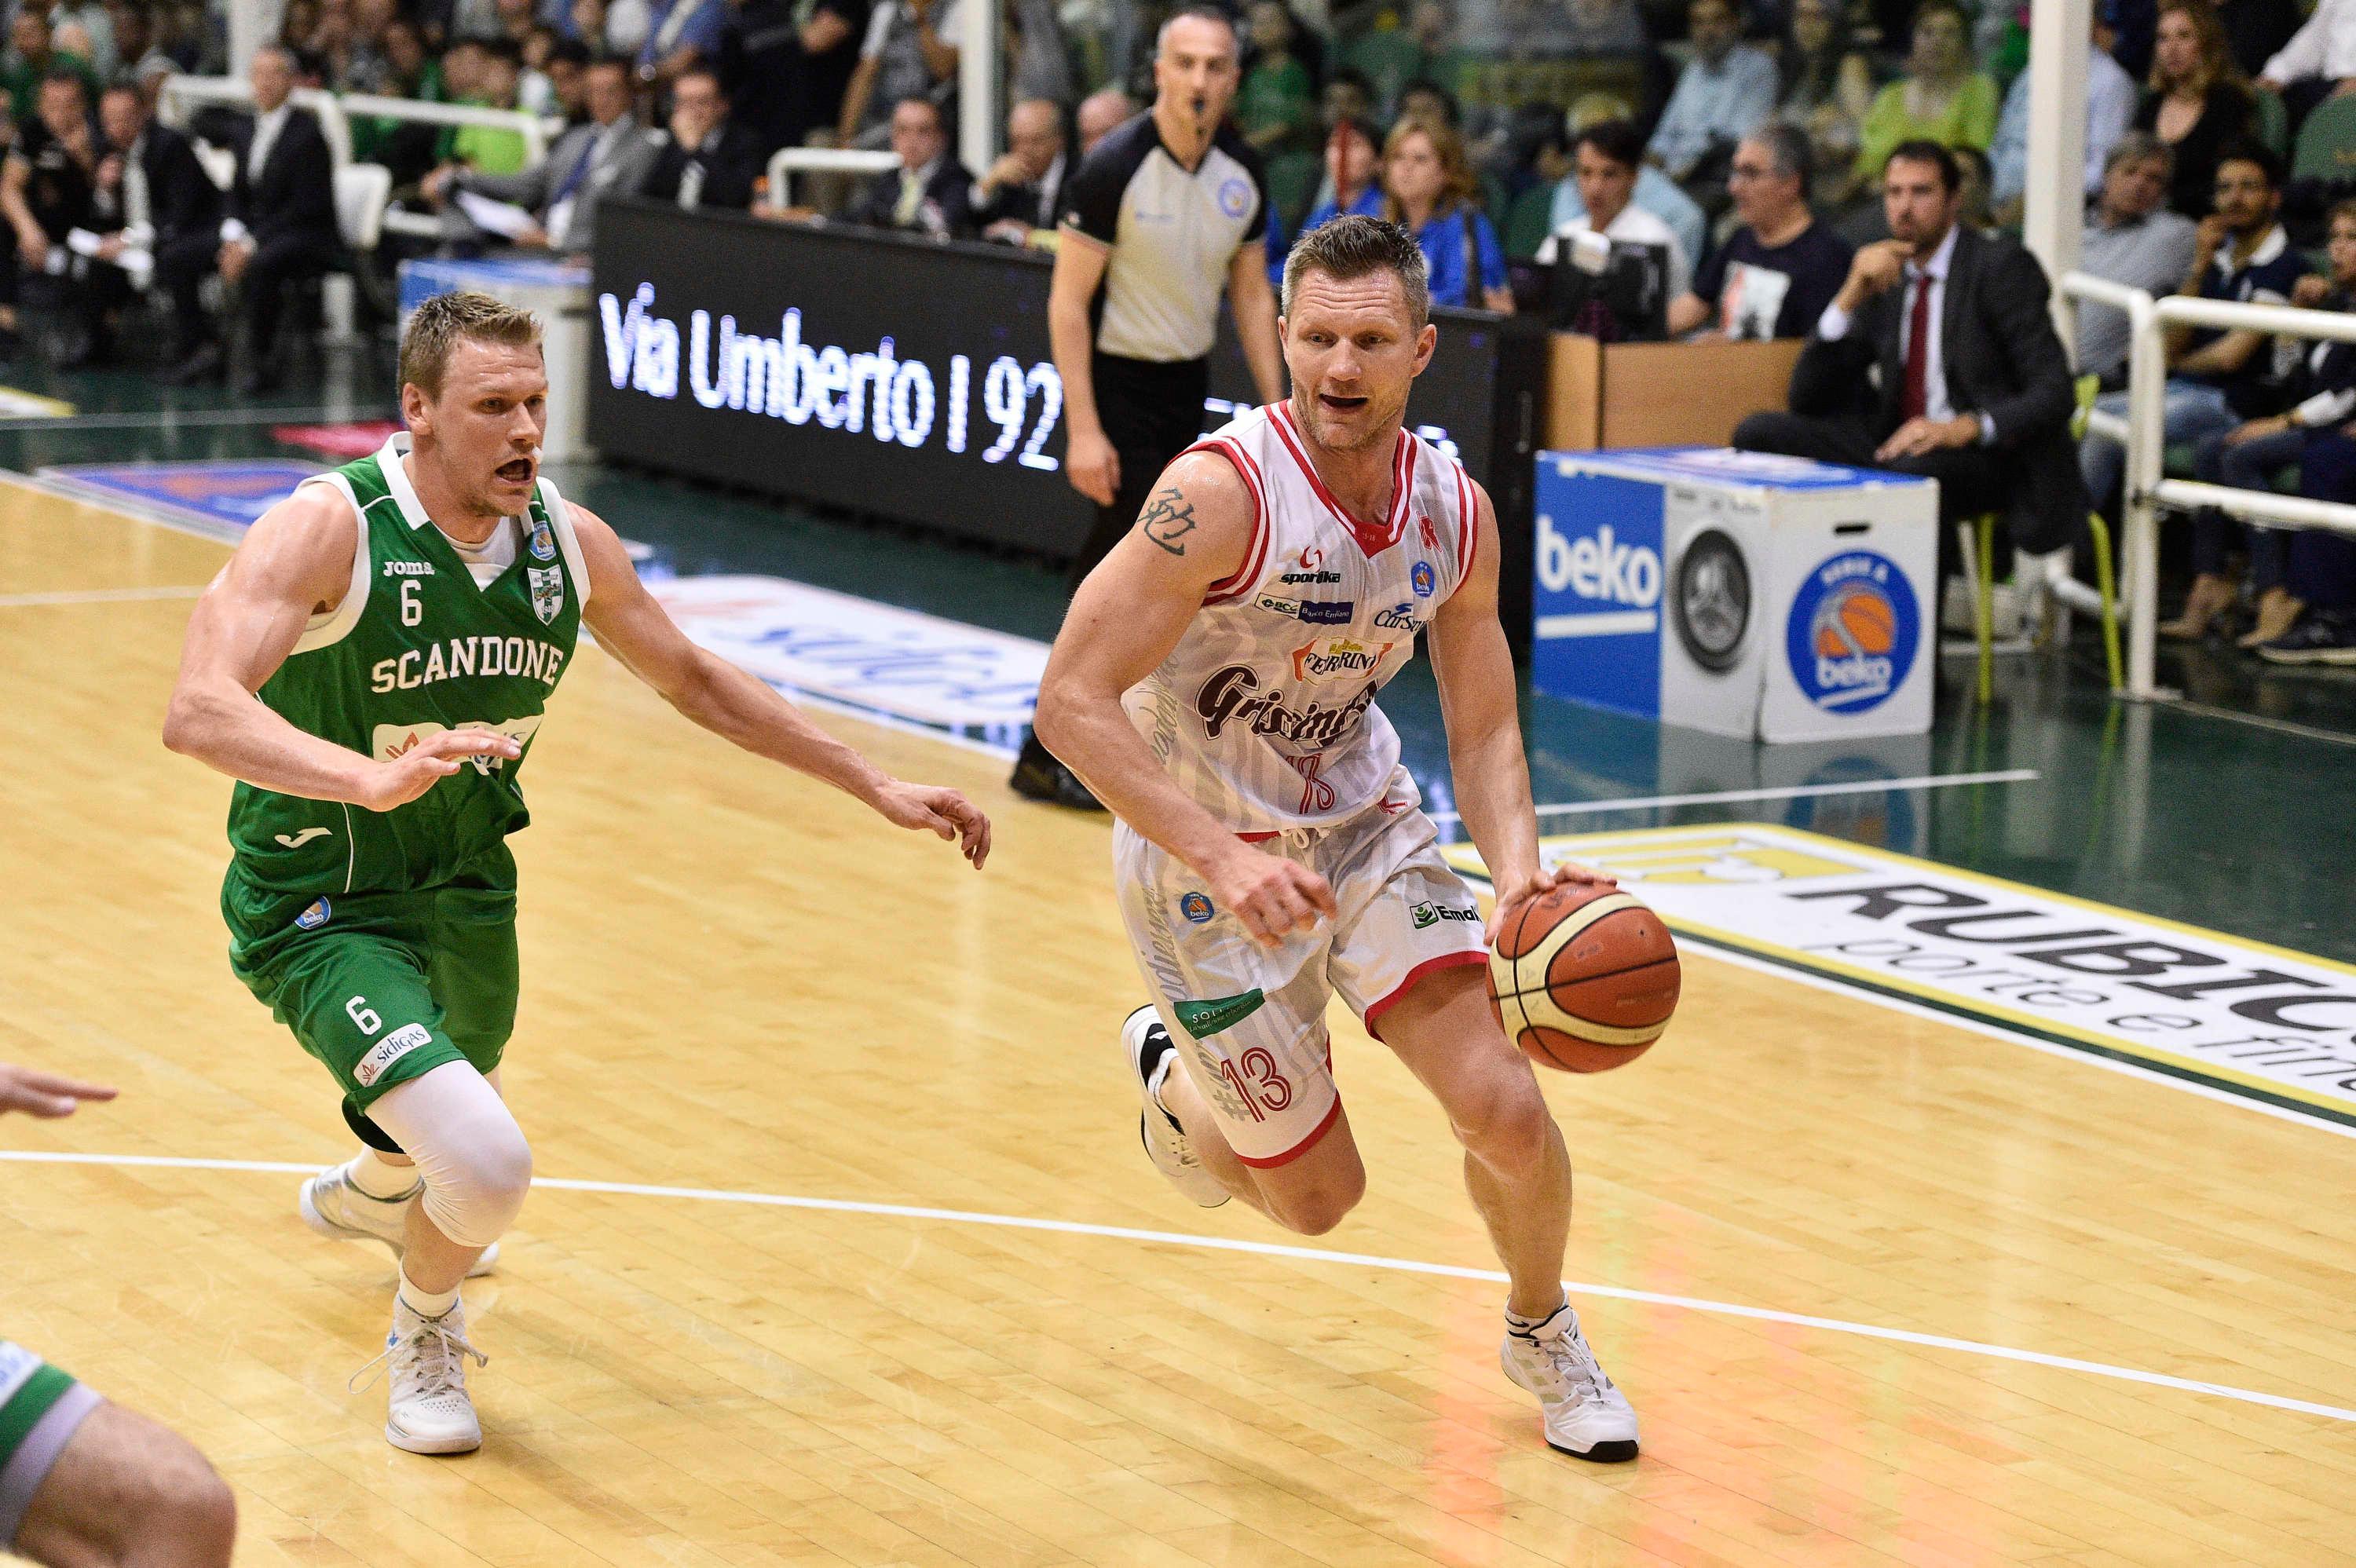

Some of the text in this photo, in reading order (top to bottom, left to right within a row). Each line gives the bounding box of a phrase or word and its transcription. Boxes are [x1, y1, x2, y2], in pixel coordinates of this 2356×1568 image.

[599, 282, 679, 399] Via
[691, 307, 935, 447] Umberto
[982, 356, 1063, 470] 92
[1536, 514, 1663, 608] beko
[400, 579, 423, 627] 6
[371, 636, 563, 693] SCANDONE
[1816, 655, 1893, 689] beko
[304, 914, 324, 924] beko
[1783, 883, 2356, 1044] RUBIC
[1801, 940, 2111, 1007] porte
[2105, 1013, 2203, 1032] e
[346, 996, 382, 1036] 6
[1220, 1047, 1292, 1123] 13
